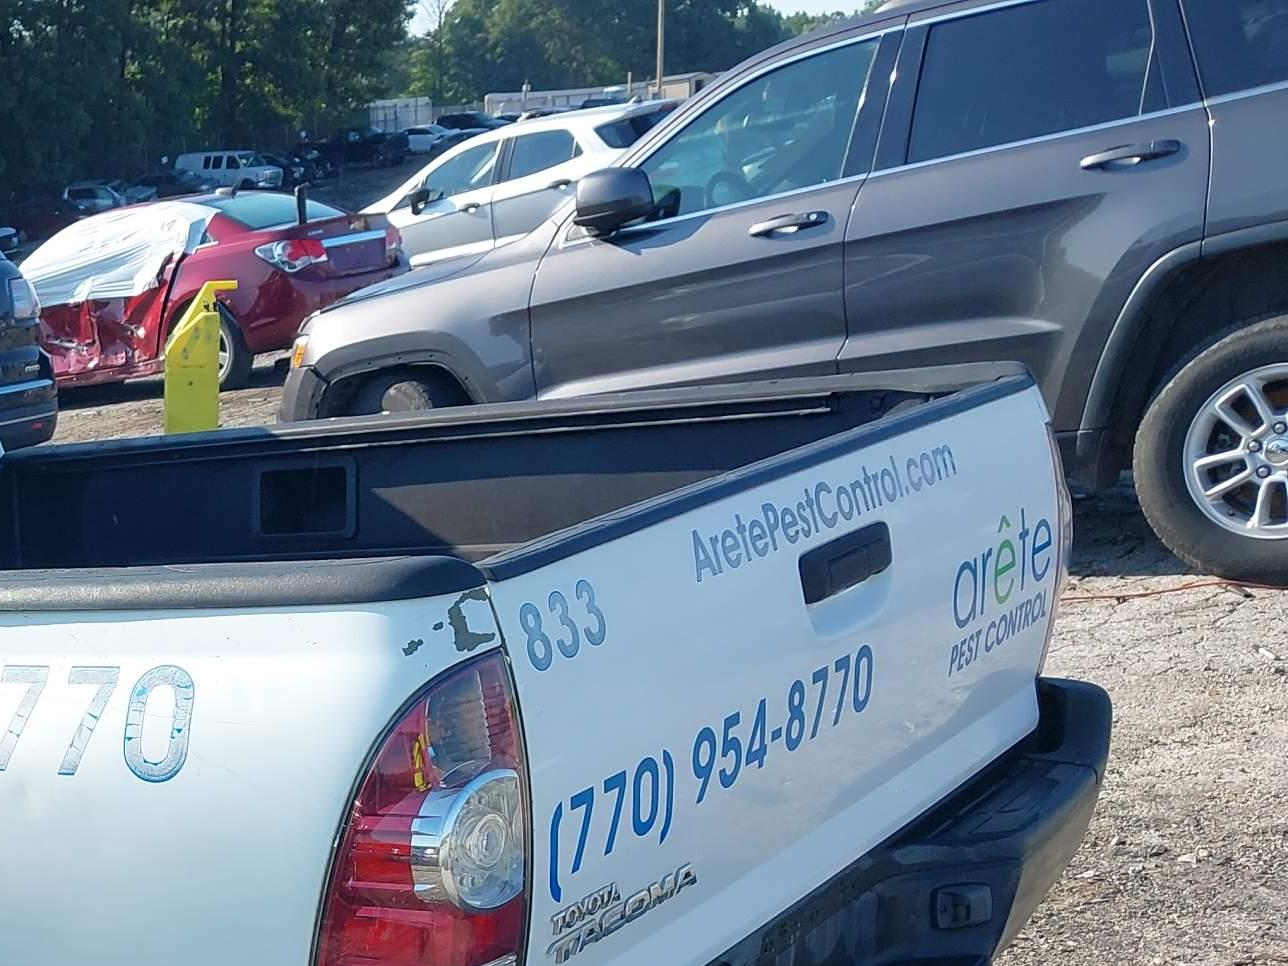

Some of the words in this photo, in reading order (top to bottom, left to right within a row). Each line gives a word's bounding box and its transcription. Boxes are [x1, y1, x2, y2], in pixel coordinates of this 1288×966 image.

[691, 443, 958, 583] AretePestControl.com
[953, 507, 1053, 629] arête
[519, 578, 607, 672] 833
[948, 628, 983, 677] PEST
[984, 588, 1047, 653] CONTROL
[549, 748, 674, 903] (770)
[692, 645, 873, 805] 954-8770
[546, 861, 698, 964] TACOMA
[550, 881, 621, 936] TOYOTA
